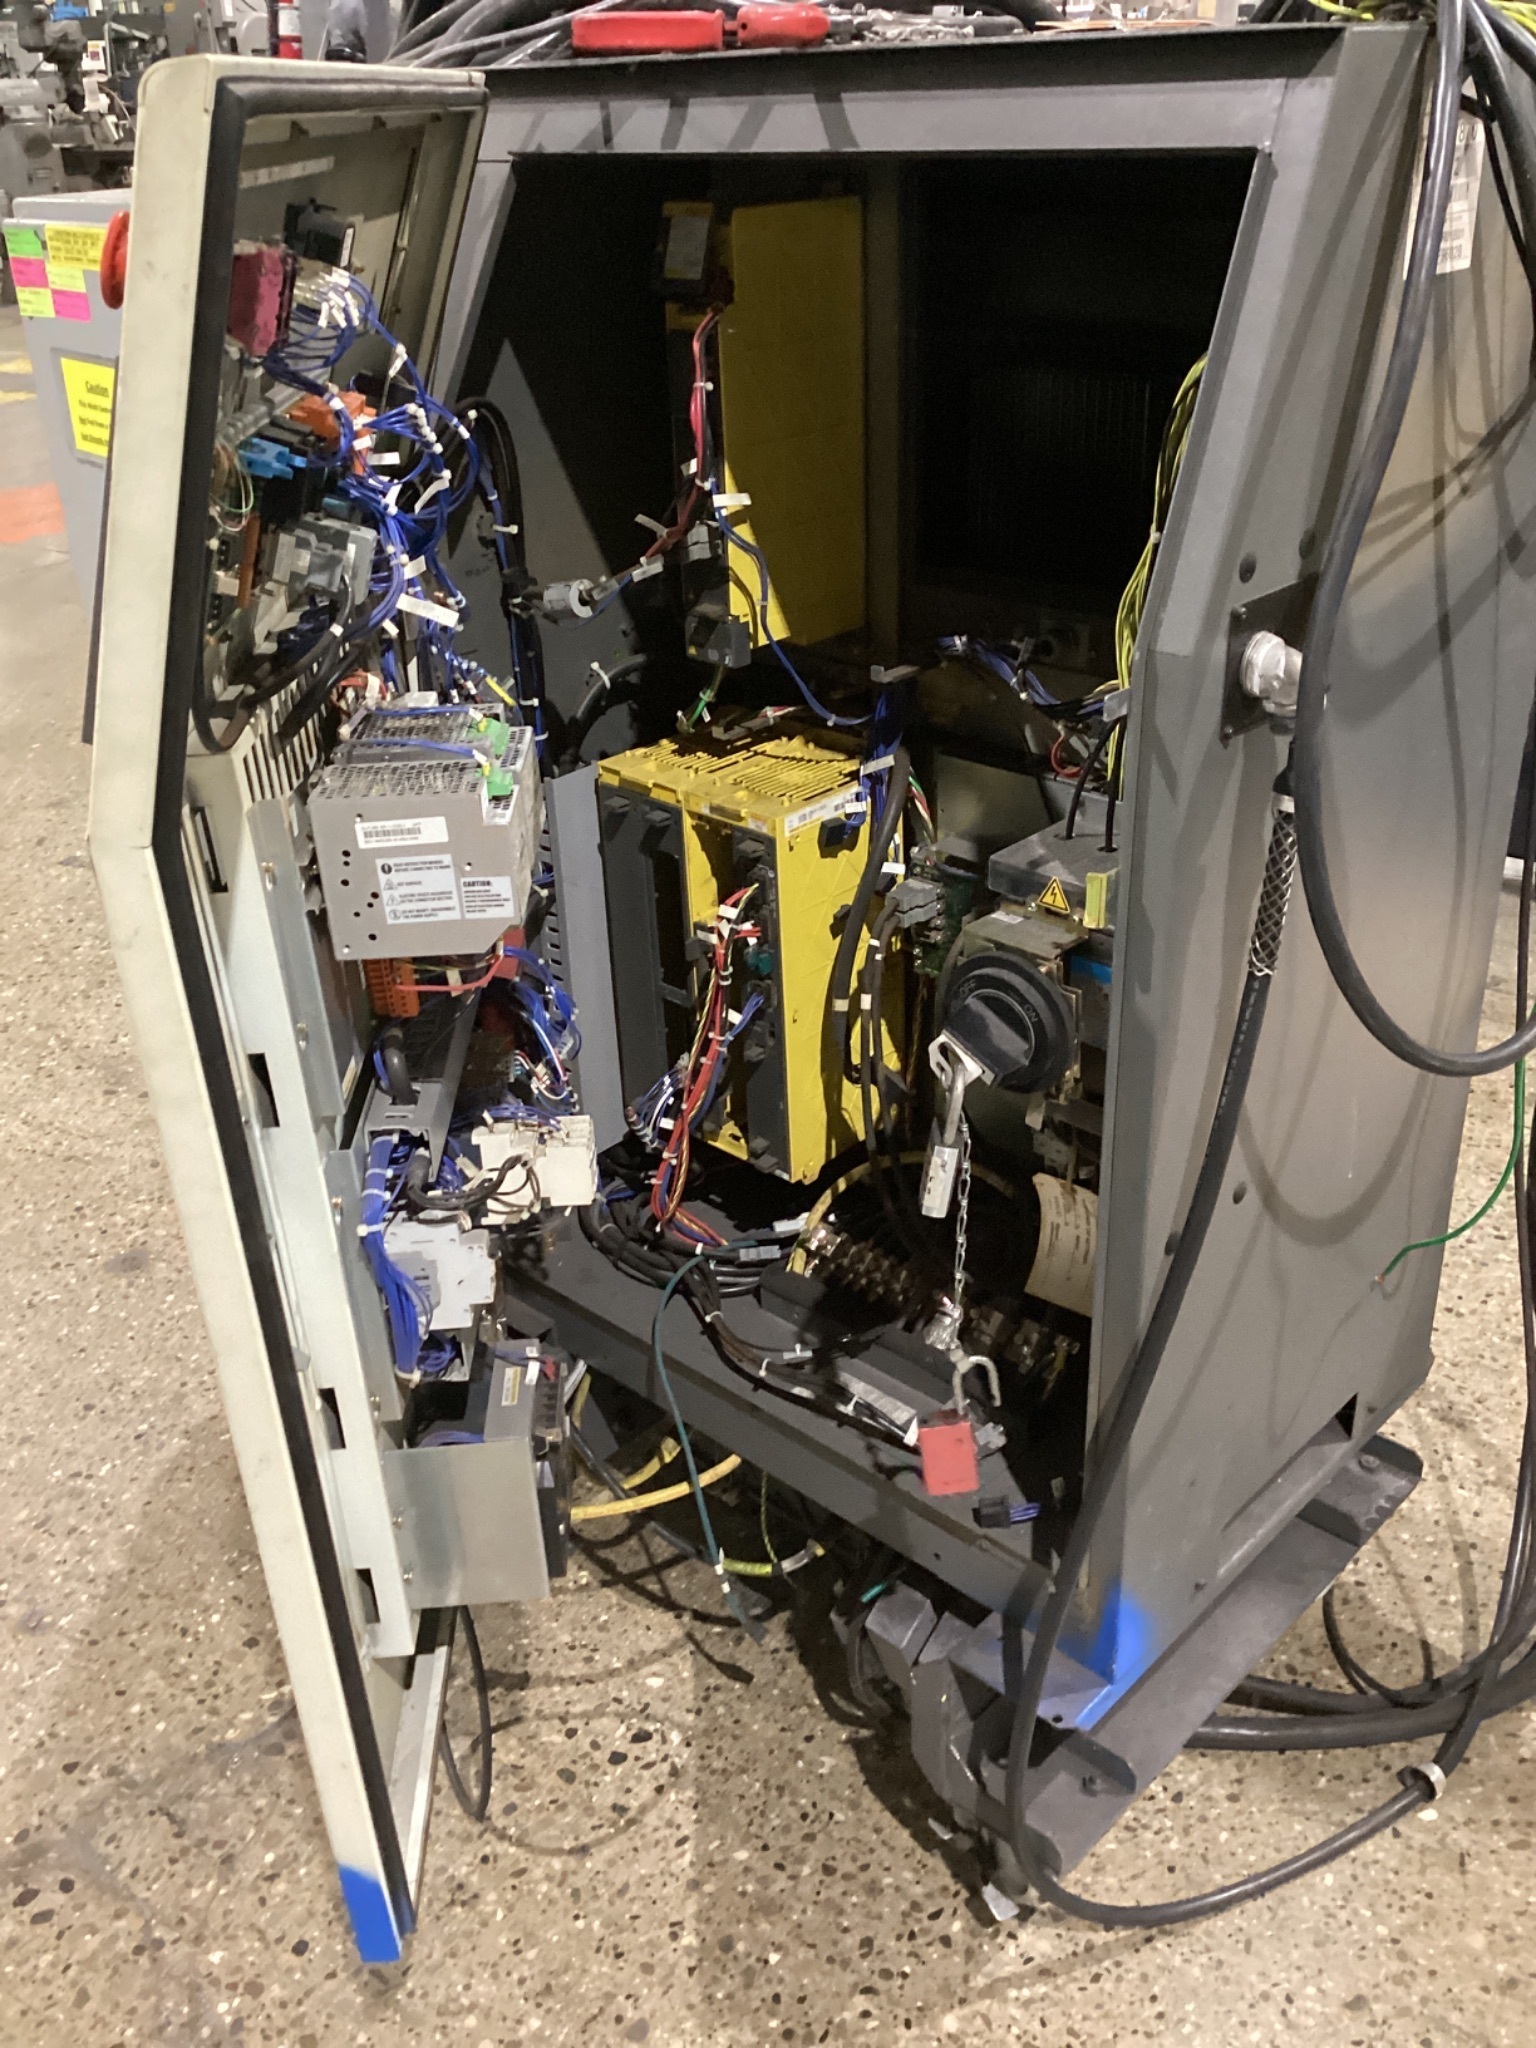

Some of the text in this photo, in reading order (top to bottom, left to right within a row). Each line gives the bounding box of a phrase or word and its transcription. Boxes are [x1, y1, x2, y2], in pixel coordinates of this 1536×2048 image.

[85, 381, 109, 397] Caution
[959, 979, 976, 996] OFF
[1023, 1004, 1039, 1023] ON
